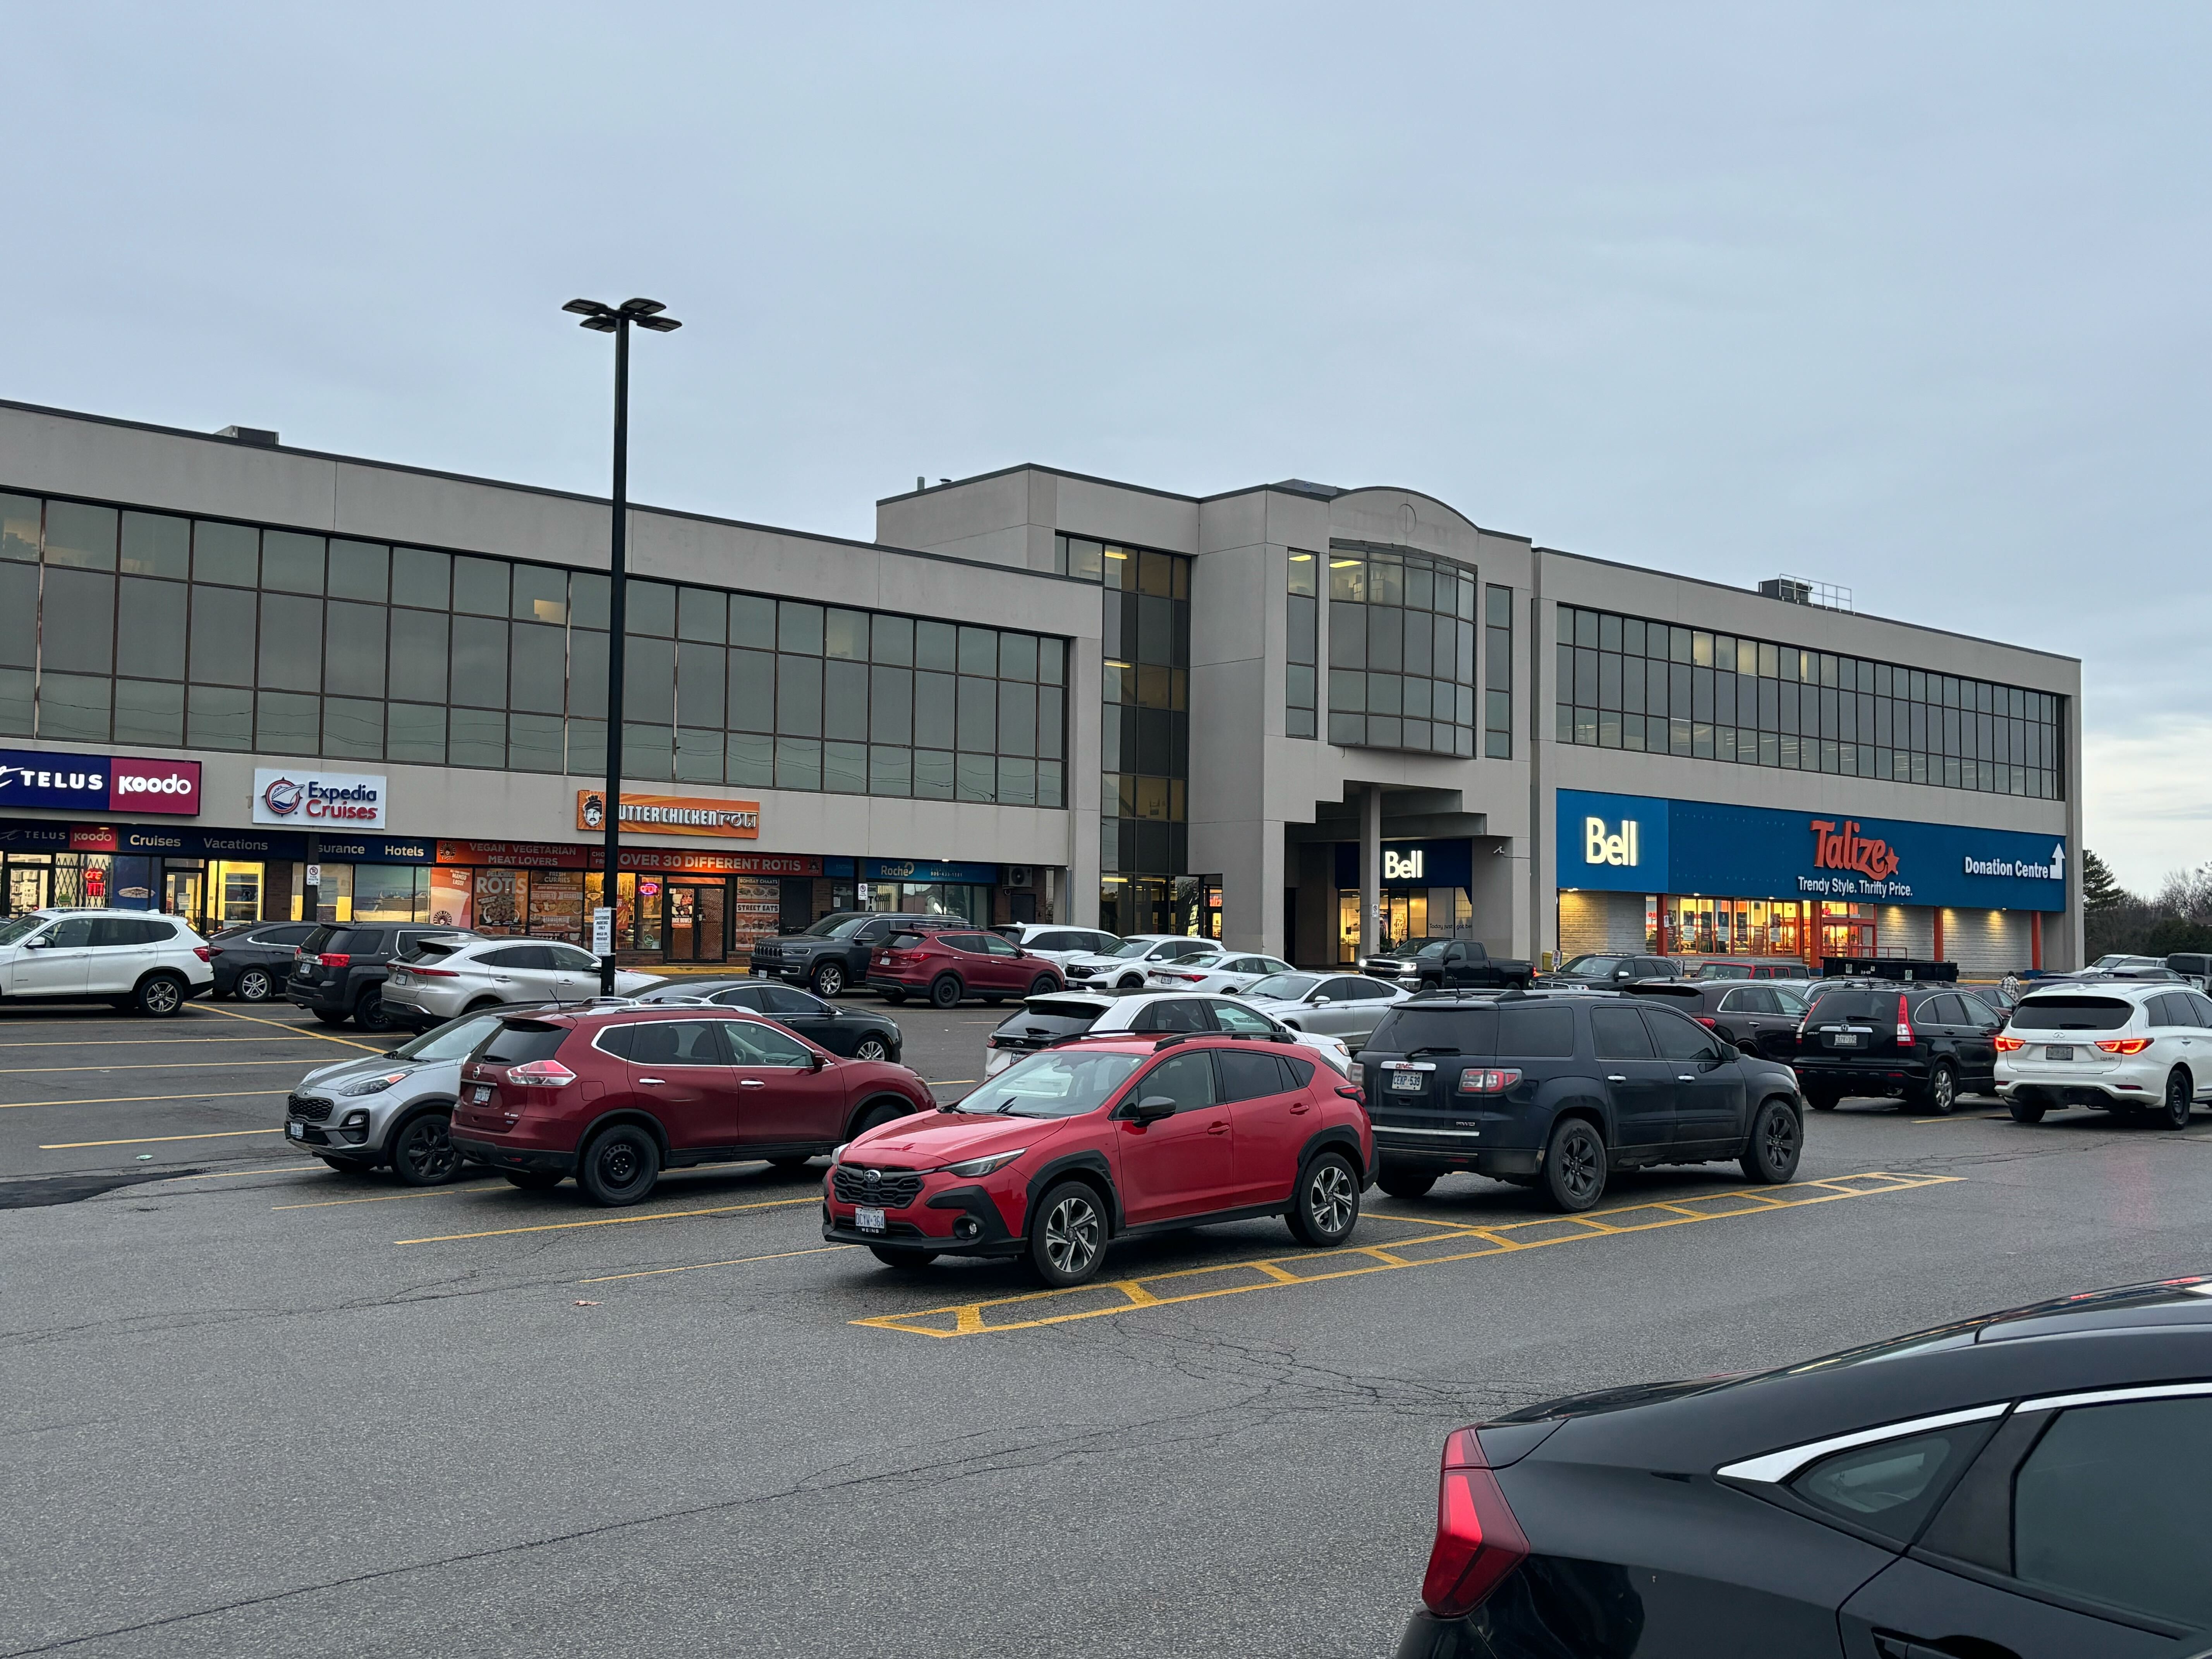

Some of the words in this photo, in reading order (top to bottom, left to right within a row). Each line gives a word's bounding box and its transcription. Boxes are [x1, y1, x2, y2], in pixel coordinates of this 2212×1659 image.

[21, 771, 103, 790] TELUS
[308, 781, 377, 804] Expedia
[306, 799, 378, 820] Cruises
[619, 804, 660, 824] UTTER
[24, 831, 65, 840] TELUS
[1587, 817, 1636, 866] Bell
[130, 835, 181, 847] Cruises
[203, 838, 268, 850] Vacations
[318, 845, 365, 854] surance
[385, 845, 424, 857] Hotels
[469, 842, 505, 852] VEGAN
[513, 845, 576, 855] VEGETARIAN
[1810, 820, 1887, 880] Talize
[488, 855, 517, 864] MEAT
[519, 856, 558, 866] LOVERS
[620, 853, 659, 866] OVER
[663, 855, 682, 867] 30
[685, 856, 759, 870] DIFFERENT
[762, 859, 801, 871] ROTIS
[1385, 850, 1422, 878] Bell
[1965, 856, 2013, 876] Donation
[2015, 860, 2049, 879] Centre
[476, 877, 528, 894] ROTIS
[1798, 876, 1830, 895] Trendy
[1832, 878, 1857, 896] Style.
[1859, 879, 1887, 898] Thrifty
[1889, 881, 1913, 896] Price.
[1409, 1076, 1420, 1086] 539
[873, 1215, 884, 1227] 364
